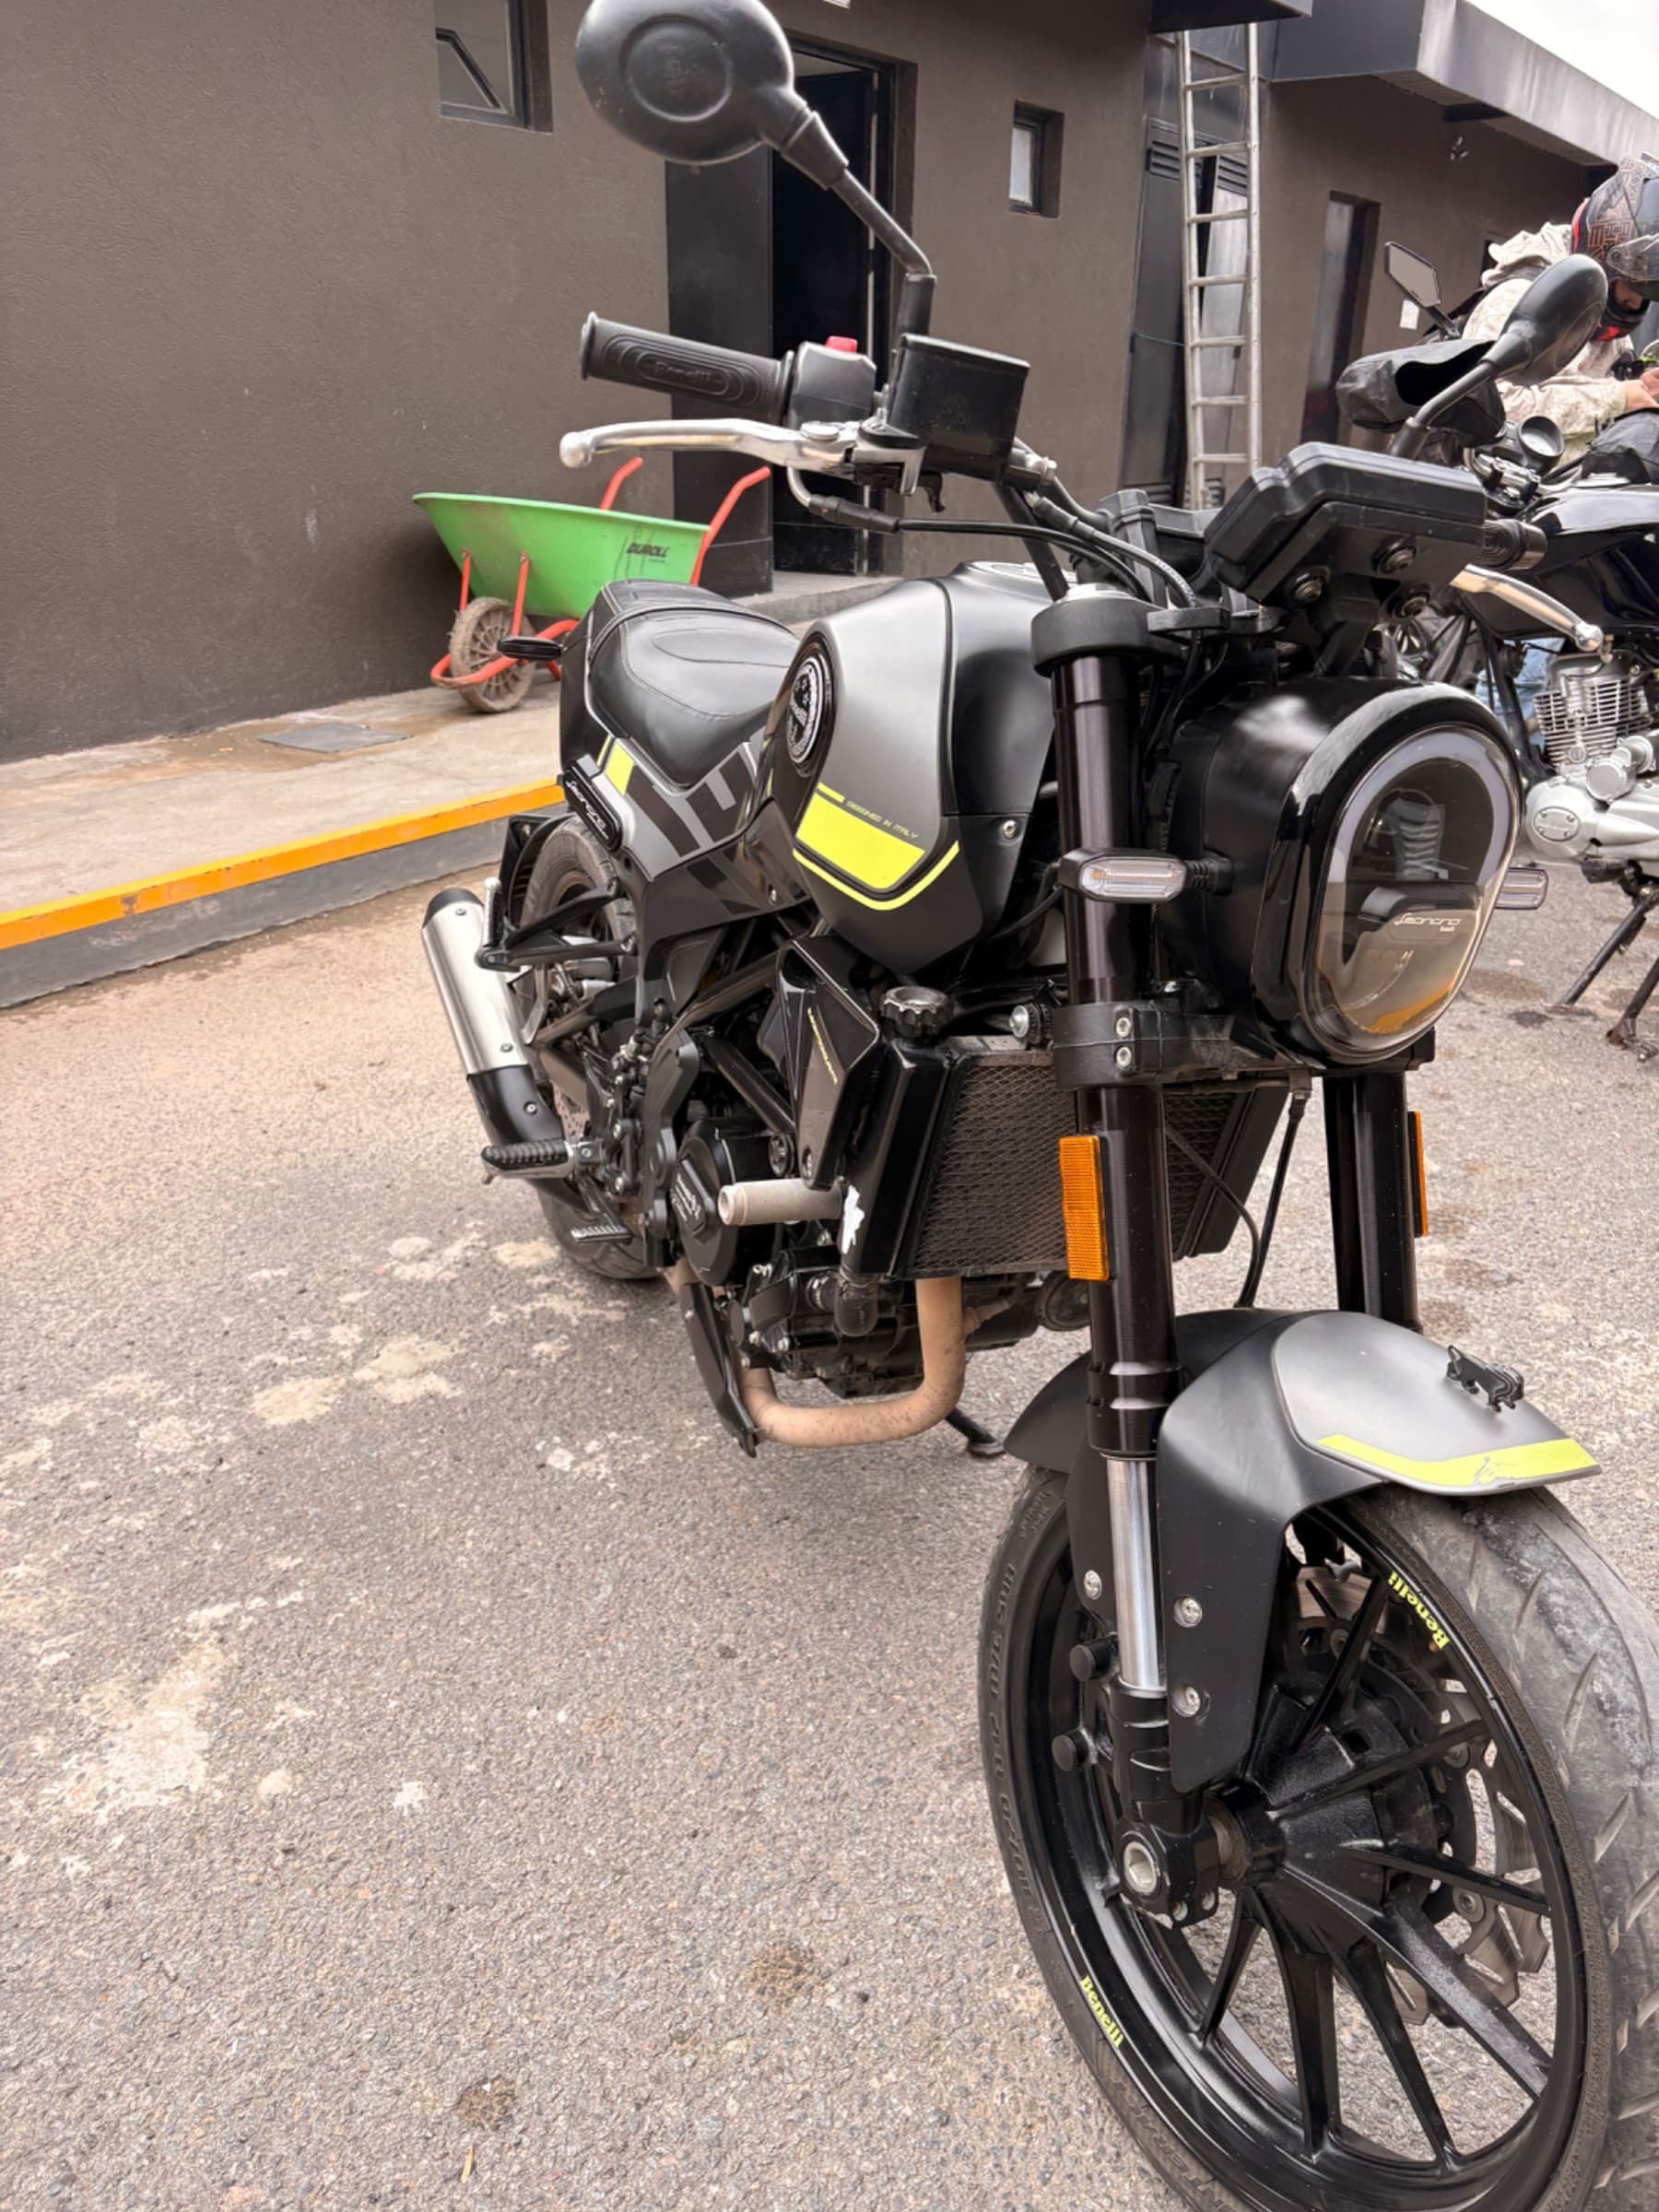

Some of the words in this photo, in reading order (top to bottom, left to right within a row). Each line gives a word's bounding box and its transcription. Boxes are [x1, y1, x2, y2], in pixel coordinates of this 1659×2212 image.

[846, 800, 882, 822] DESIGNED
[891, 823, 920, 839] ITALY
[1388, 1571, 1450, 1650] Benelli
[1077, 1975, 1124, 2048] Benelli
